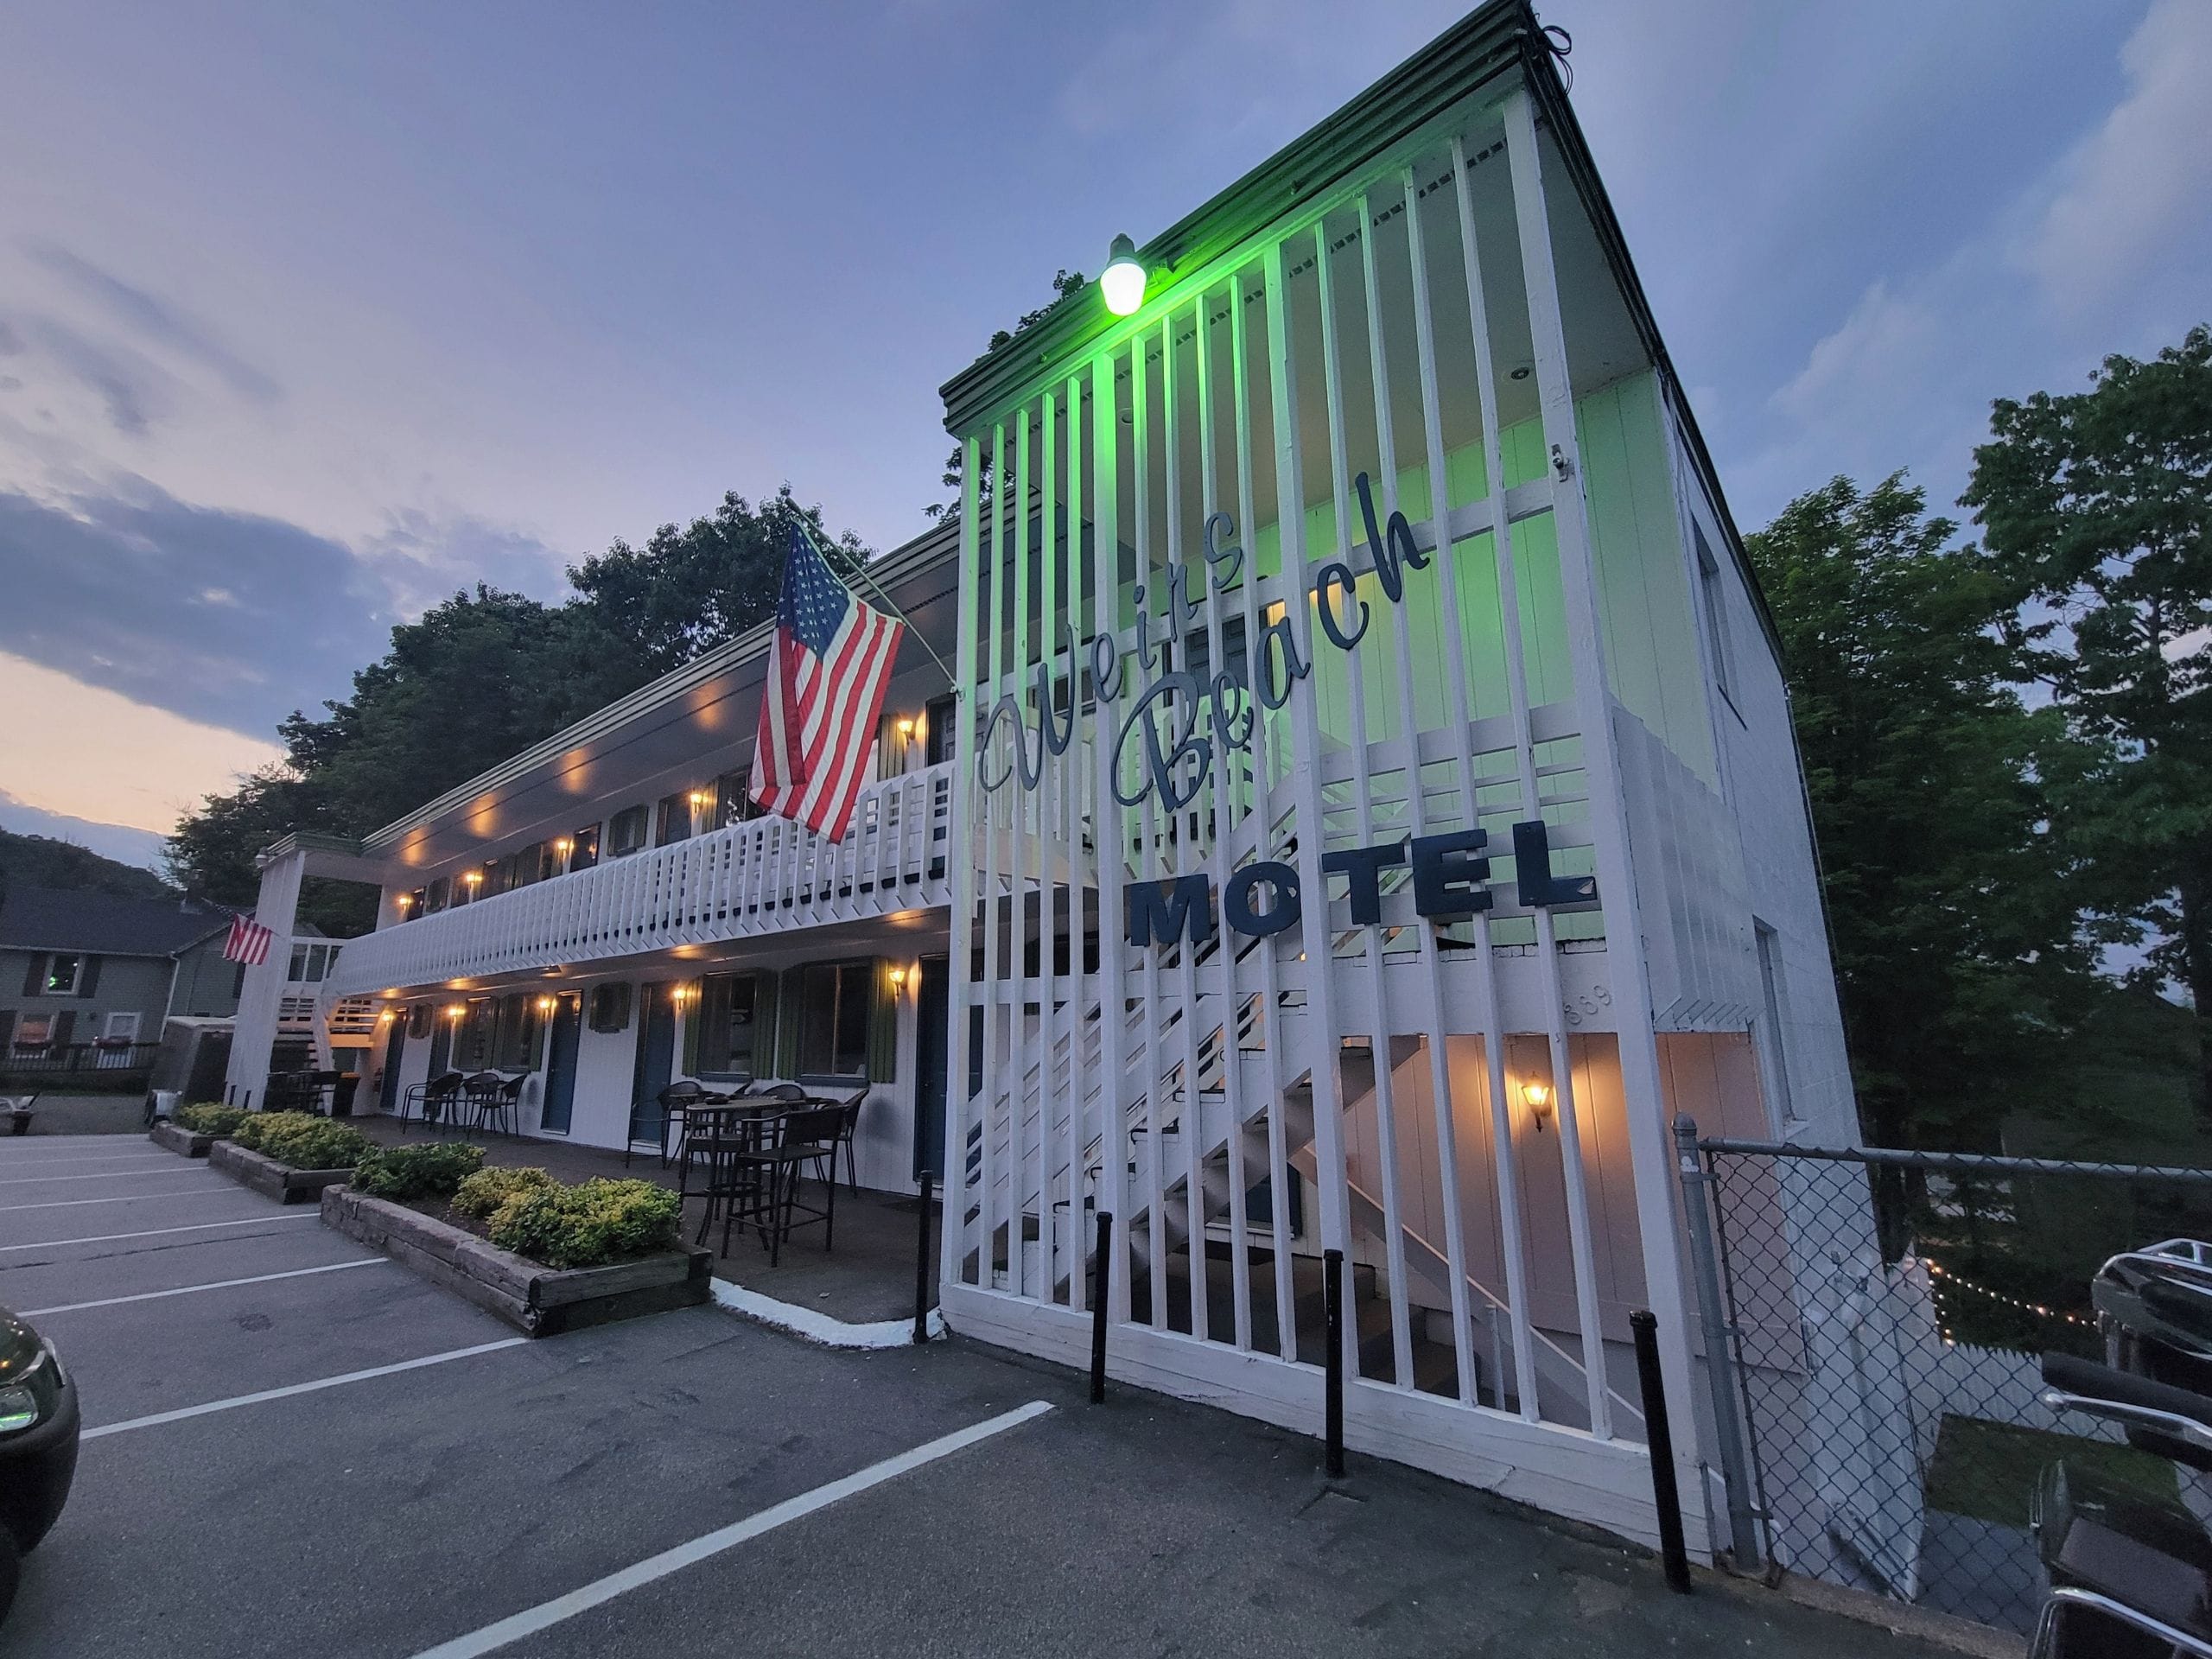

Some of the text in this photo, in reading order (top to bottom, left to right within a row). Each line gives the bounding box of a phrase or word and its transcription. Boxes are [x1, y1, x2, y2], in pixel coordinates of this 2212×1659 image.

[980, 512, 1243, 792] Weirs
[1111, 471, 1430, 813] Beach
[1124, 820, 1598, 947] MOTEL
